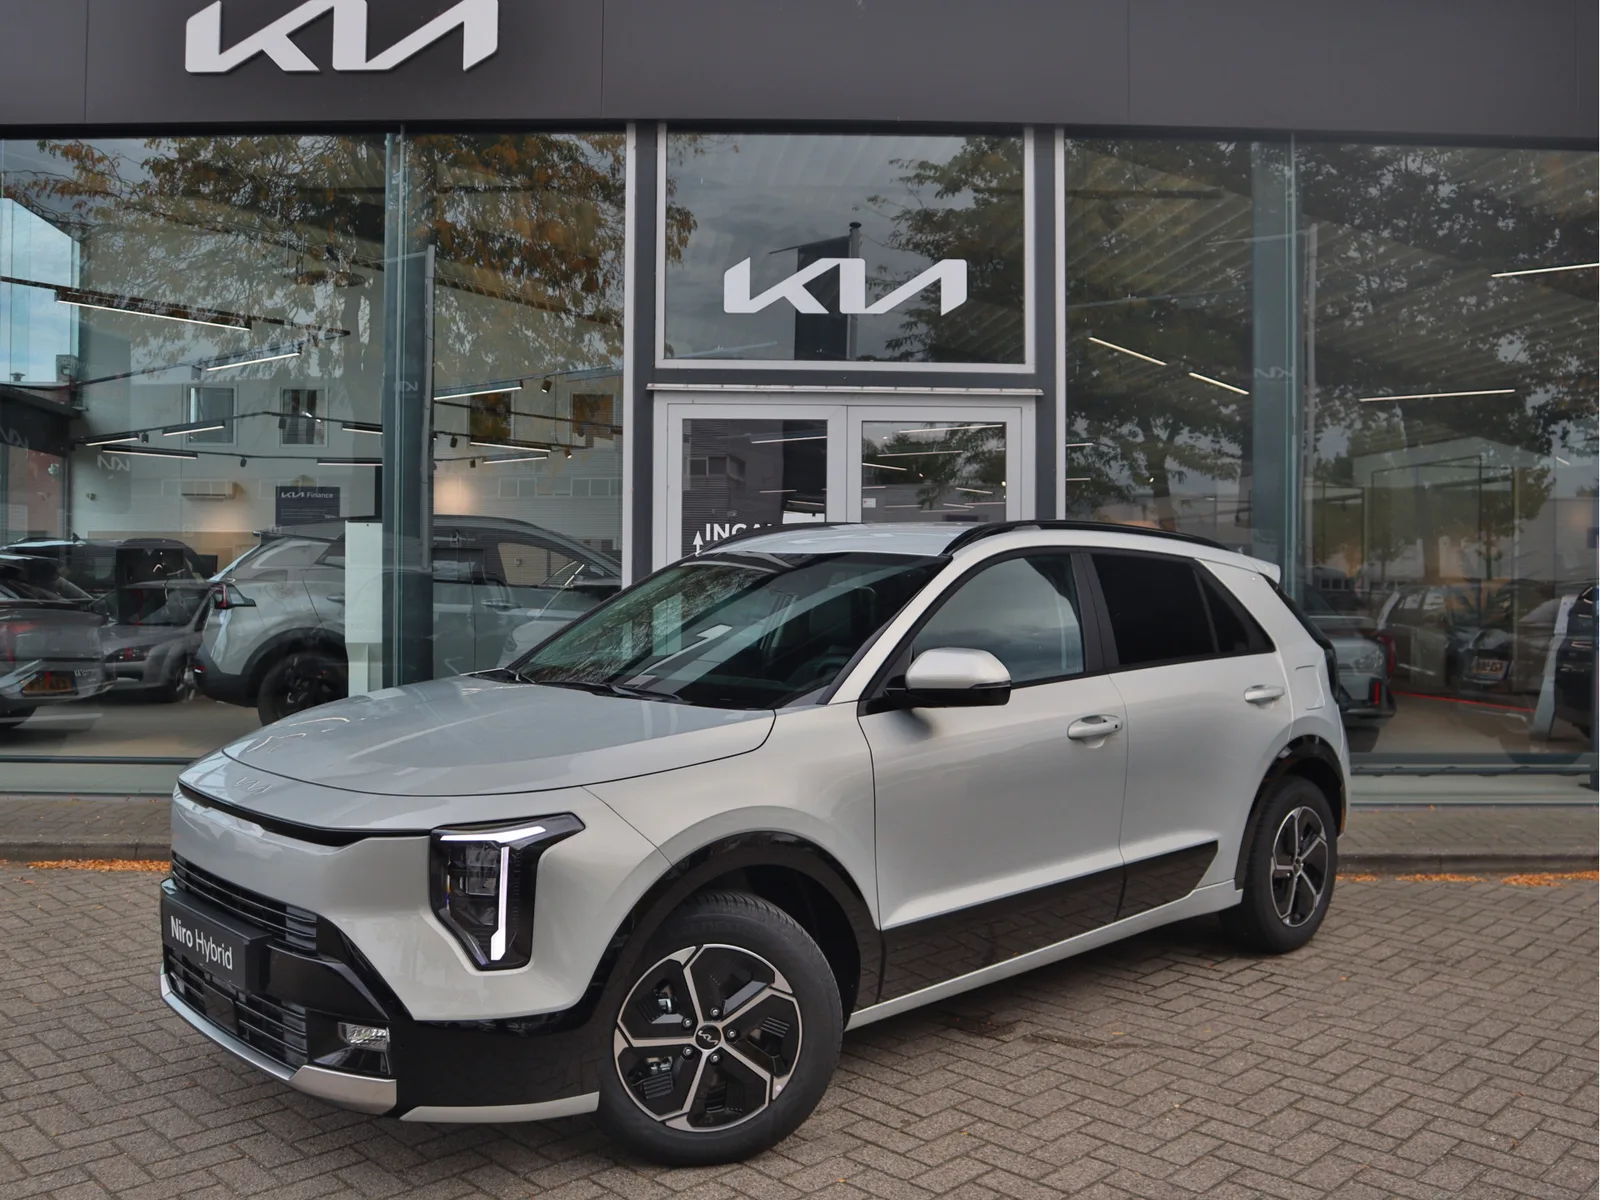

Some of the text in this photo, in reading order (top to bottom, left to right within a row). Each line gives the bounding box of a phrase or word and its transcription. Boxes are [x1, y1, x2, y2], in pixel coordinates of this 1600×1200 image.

[185, 0, 498, 73] KIA
[724, 257, 967, 316] KIA
[281, 491, 334, 499] KIA Finance
[170, 915, 233, 970] Niro Hybrid
